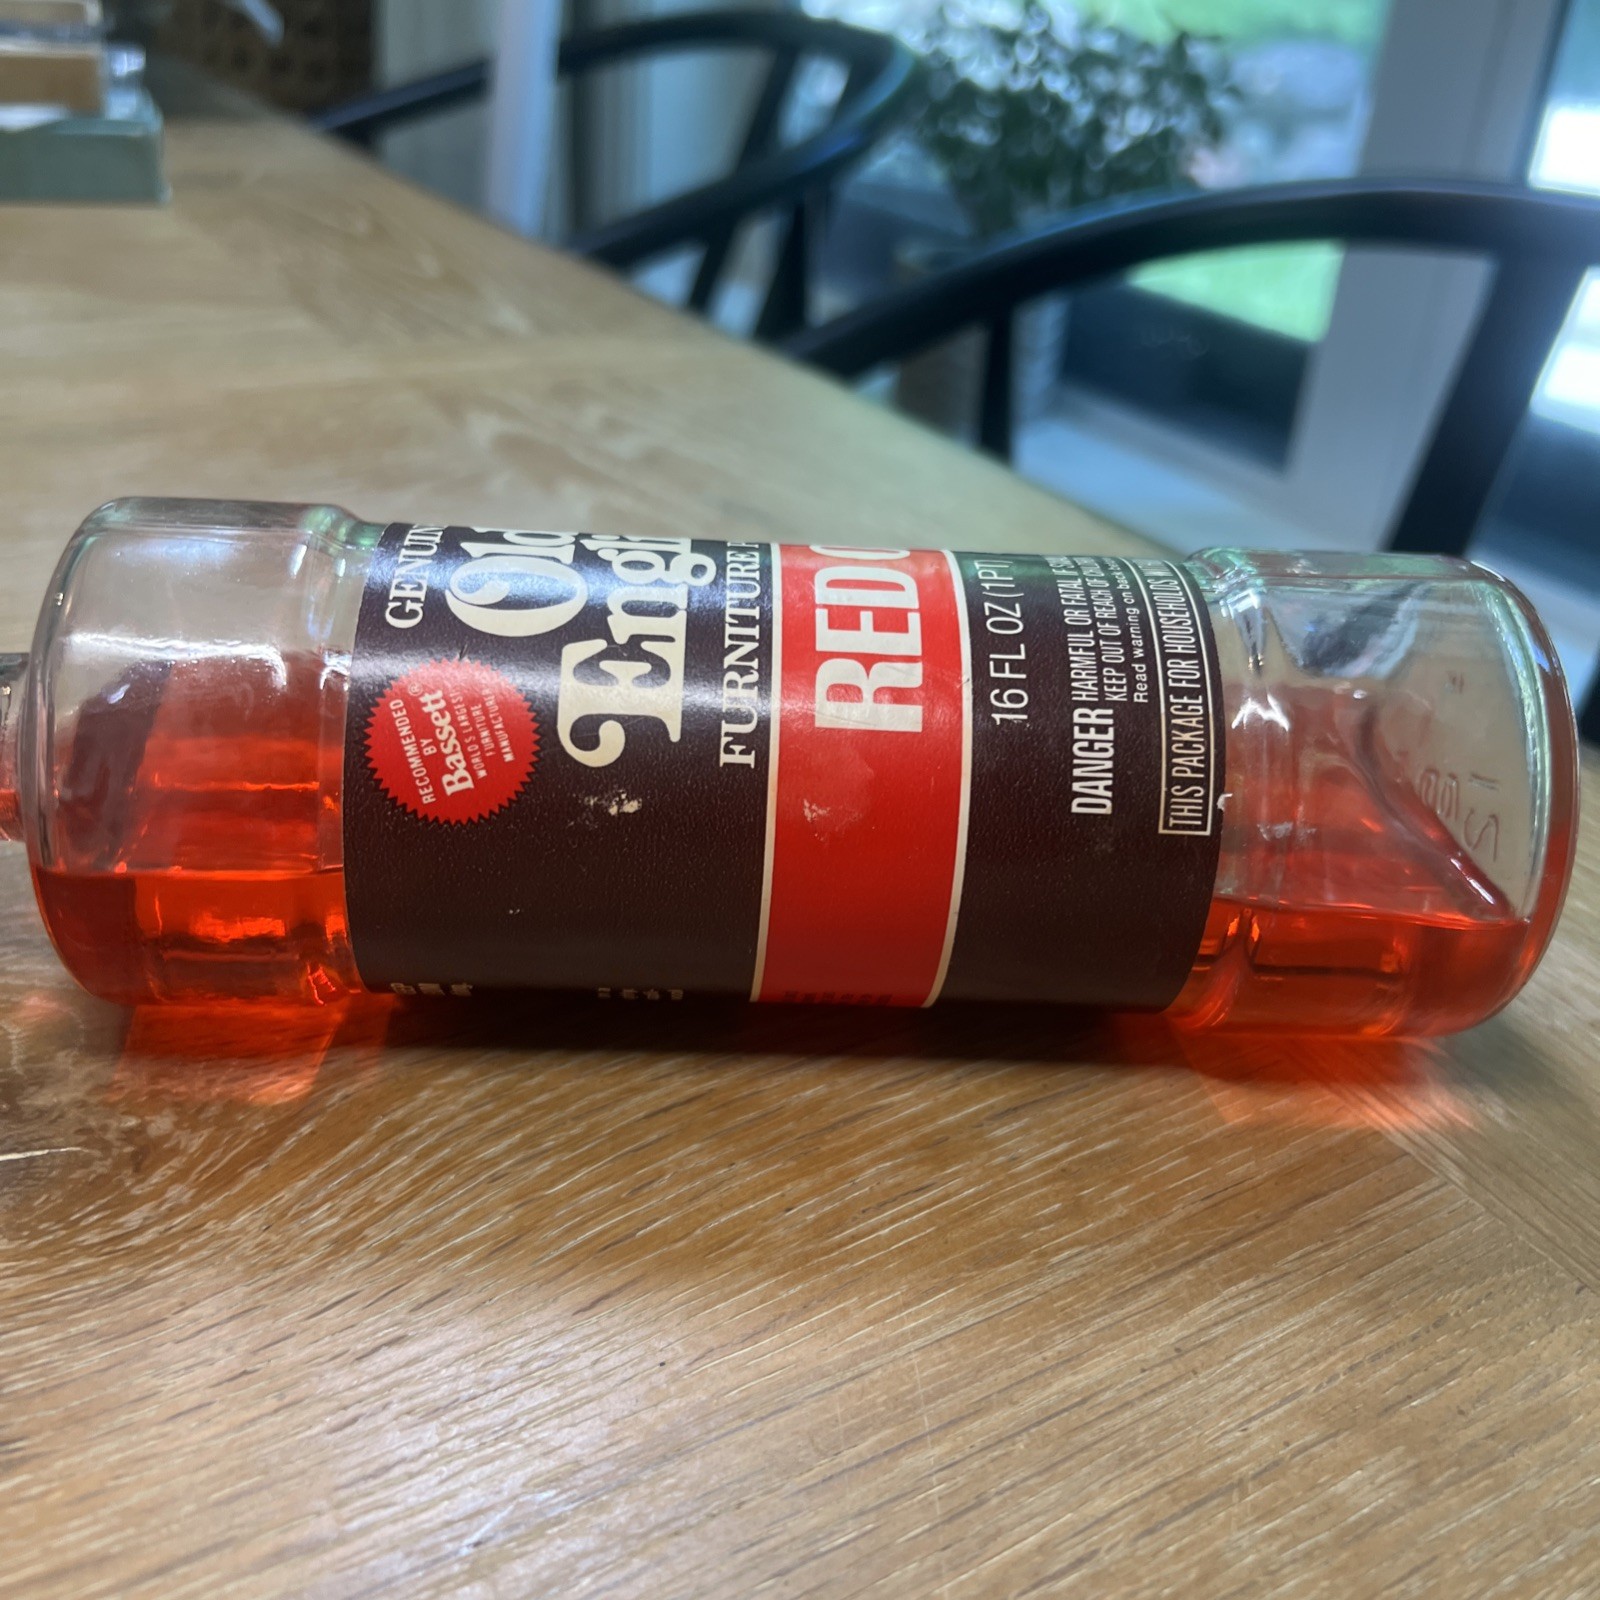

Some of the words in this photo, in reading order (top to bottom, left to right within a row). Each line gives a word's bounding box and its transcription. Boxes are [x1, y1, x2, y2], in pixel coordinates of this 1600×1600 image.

[1056, 578, 1088, 606] FATAL
[1090, 589, 1118, 618] REACH
[1121, 591, 1135, 604] on
[983, 601, 1025, 635] OZ
[1063, 609, 1092, 625] OR
[1096, 621, 1121, 636] OF
[1125, 607, 1144, 659] warning
[1146, 579, 1198, 653] HOUSEHOLDS
[719, 550, 762, 769] FURNITURE
[814, 565, 923, 733] RED
[989, 643, 1028, 679] FL
[1066, 630, 1099, 701] HARMFUL
[1099, 639, 1125, 664] OUT
[1102, 667, 1127, 701] KEEP
[1131, 663, 1149, 703] Read
[1166, 658, 1201, 688] FOR
[989, 688, 1029, 726] 16
[418, 689, 475, 797] Bassett
[419, 737, 438, 757] BY
[471, 703, 497, 757] FURNITURE
[1169, 694, 1206, 777] PACKAGE
[389, 699, 437, 805] RECOMMENDED
[1070, 707, 1115, 815] DANGER
[1168, 785, 1205, 827] THIS
